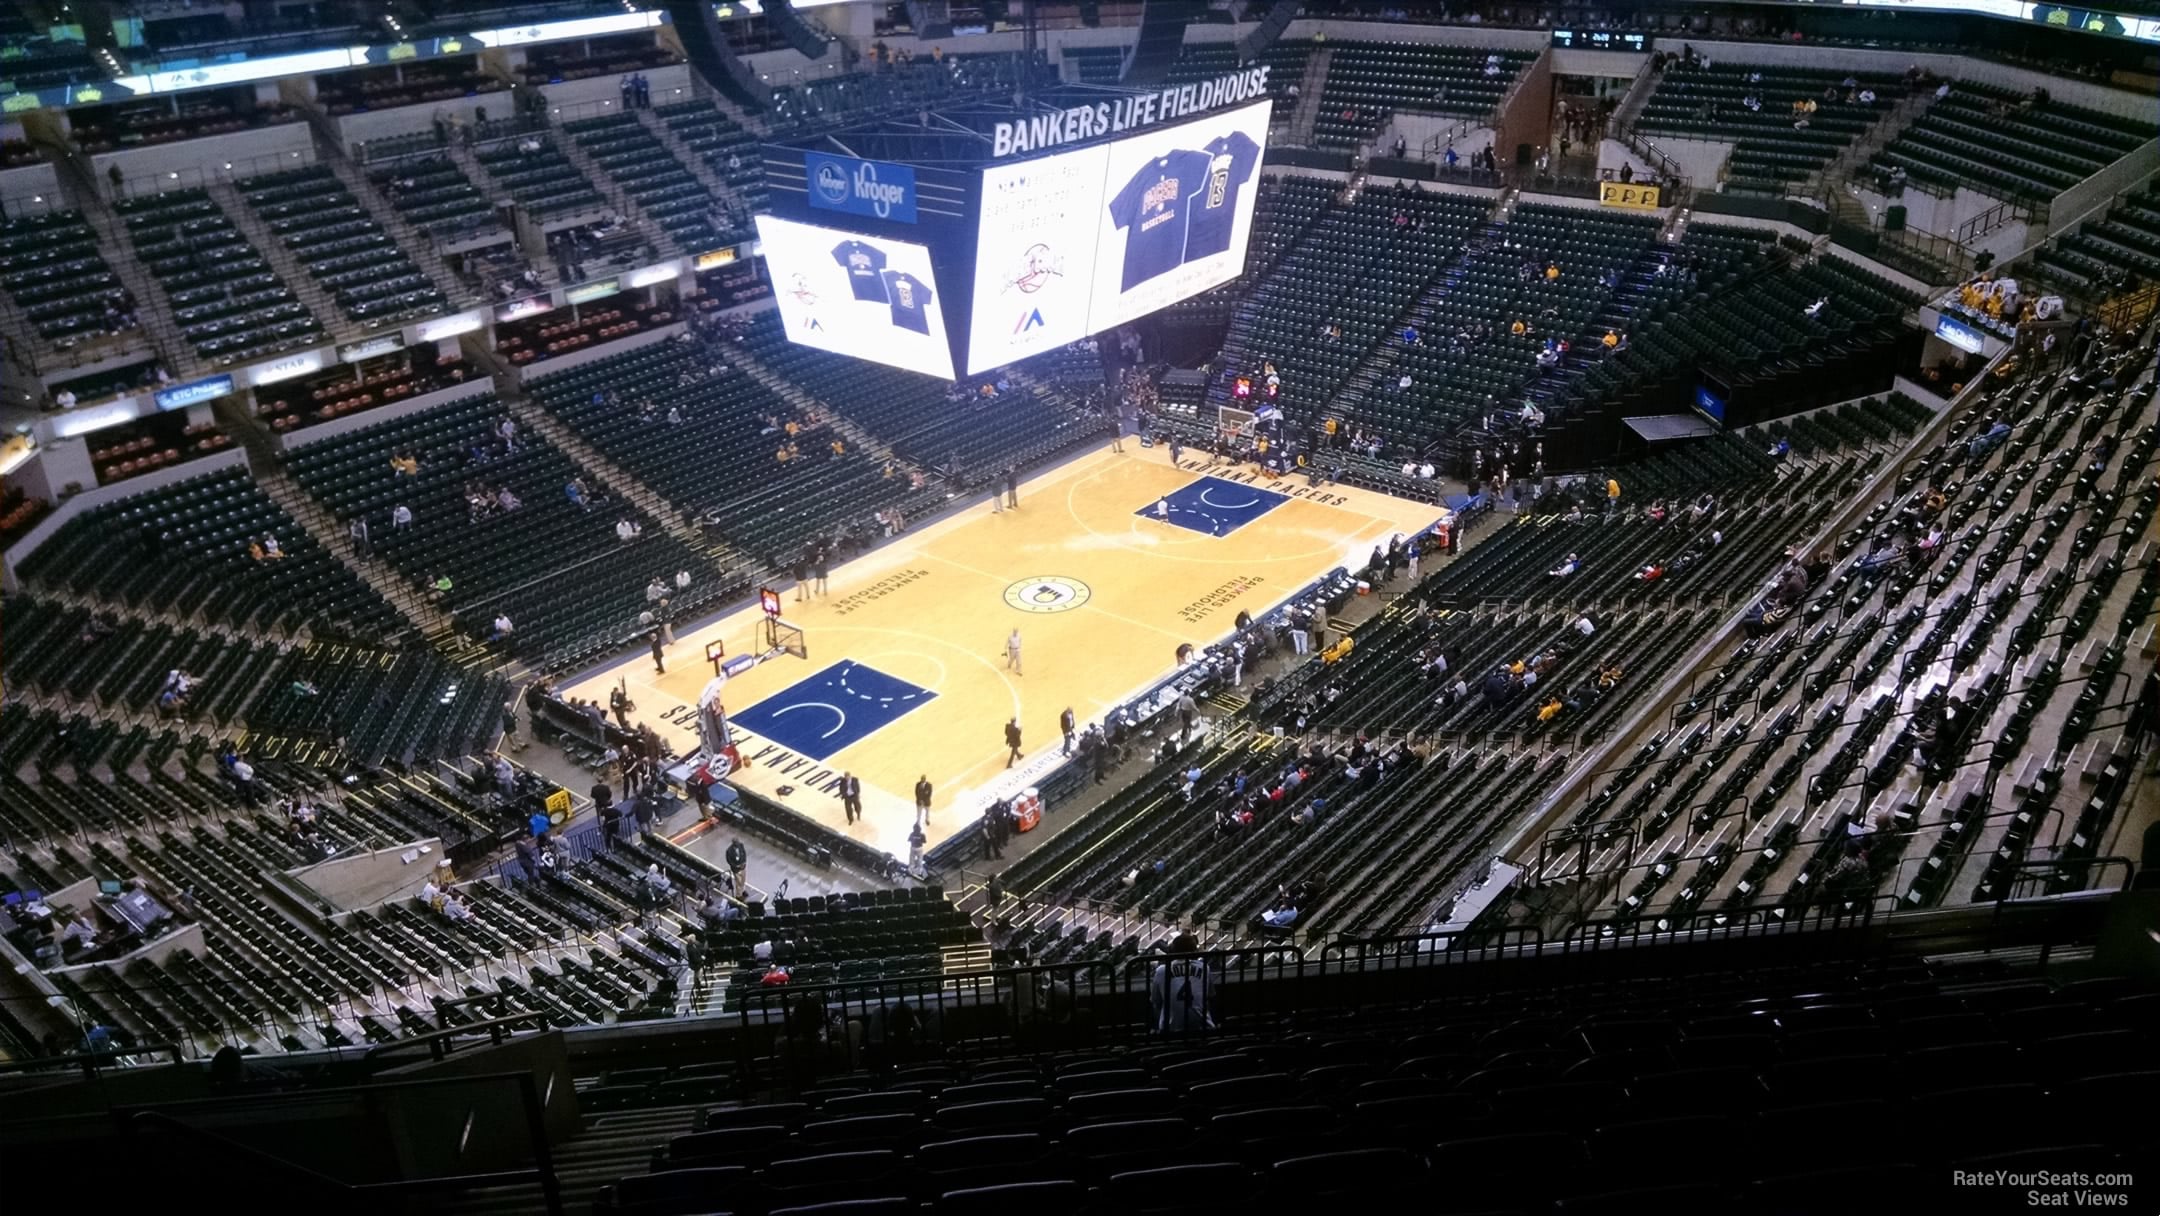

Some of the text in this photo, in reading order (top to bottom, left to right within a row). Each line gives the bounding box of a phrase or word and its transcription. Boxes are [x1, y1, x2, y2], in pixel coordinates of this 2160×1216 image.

[993, 66, 1271, 157] BANKERS LIFE FIELDHOUSE
[853, 162, 904, 218] Kroger
[1206, 170, 1229, 209] 13
[1177, 458, 1348, 507] INDIANA PACERS
[831, 569, 915, 608] FIELDHOUSE
[834, 570, 929, 615] BANKERS LIFE
[1177, 575, 1249, 617] FIELDHOUSE
[1184, 576, 1265, 623] BANKERS LIFE
